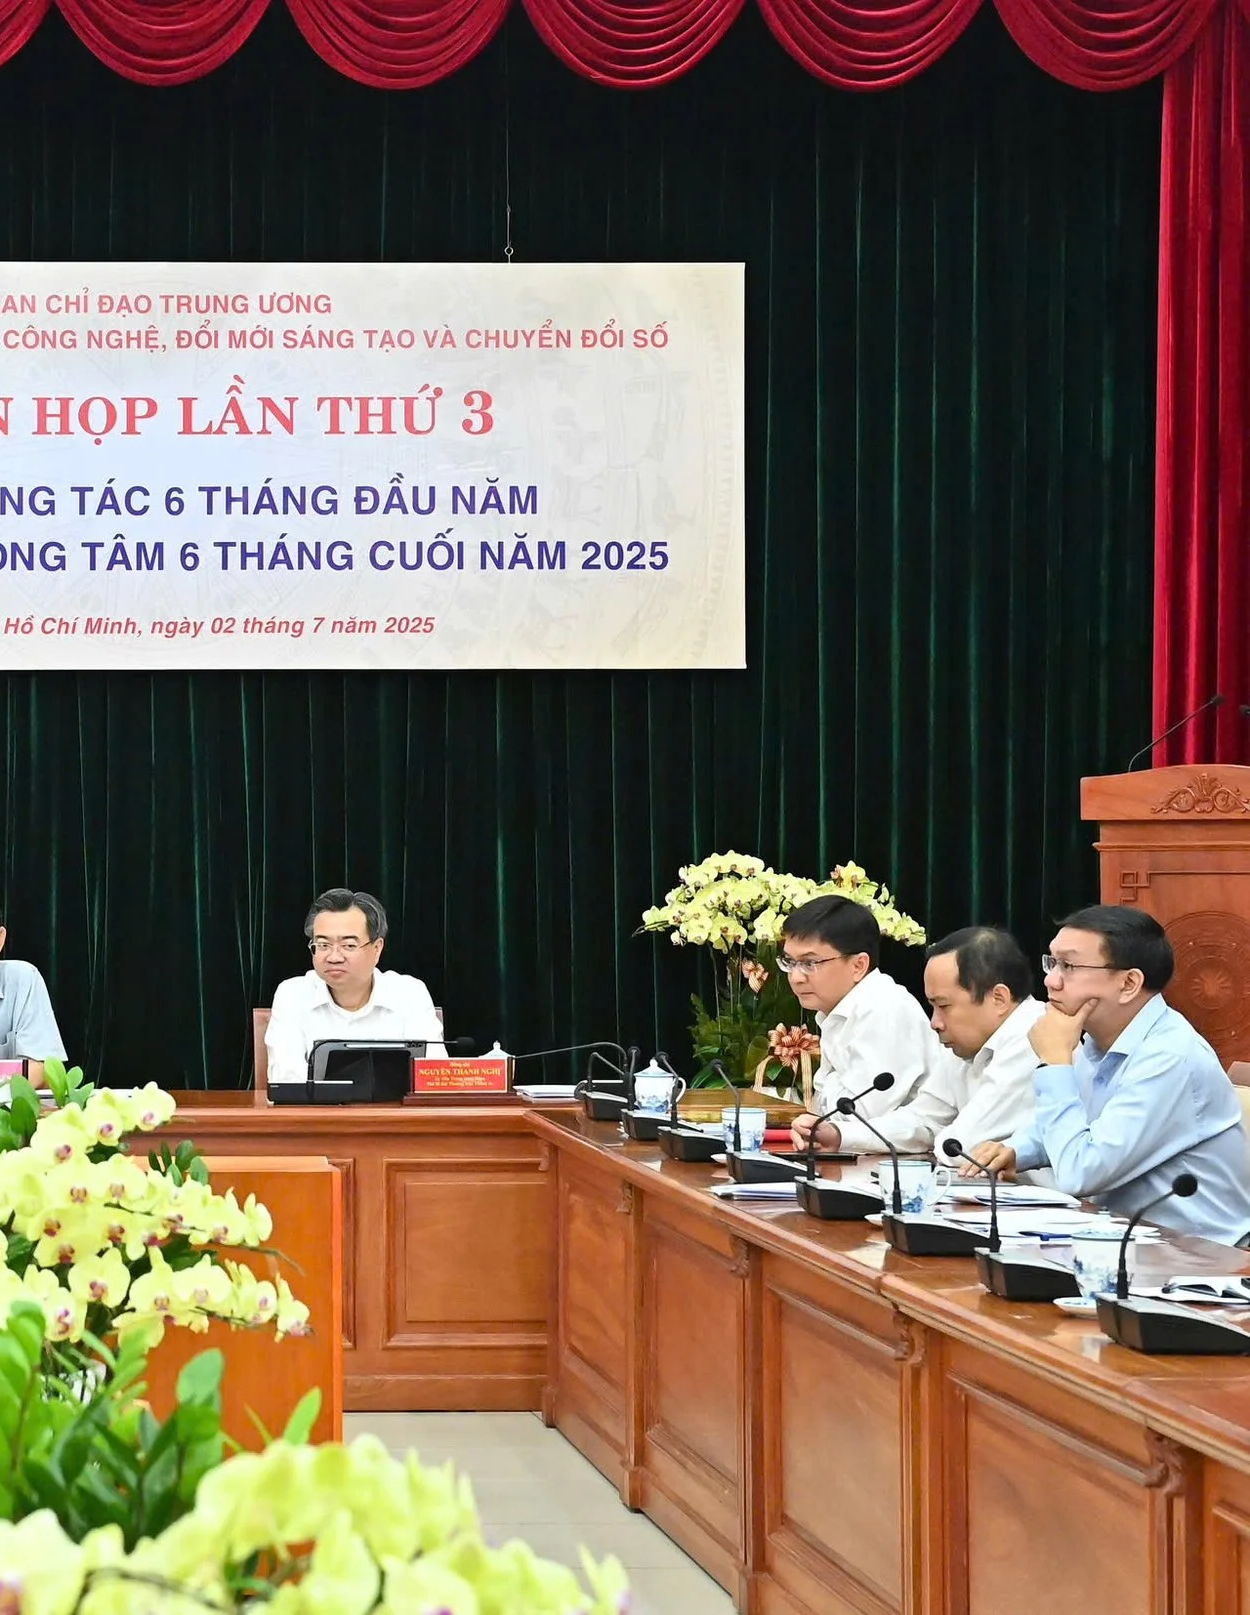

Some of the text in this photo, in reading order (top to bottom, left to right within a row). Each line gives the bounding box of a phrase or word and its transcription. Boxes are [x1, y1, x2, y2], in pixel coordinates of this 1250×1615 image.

[46, 286, 91, 316] CHỈ
[97, 293, 154, 320] ĐẠO
[159, 293, 251, 316] TRUNG
[259, 291, 334, 316] ƯƠNG
[3, 325, 79, 351] CÔNG
[87, 325, 168, 355] NGHỆ,
[176, 319, 220, 351] ĐỔI
[229, 325, 275, 351] MỚI
[283, 325, 355, 351] SÁNG
[363, 330, 416, 354] TẠO
[423, 325, 458, 350] VÀ
[466, 319, 573, 350] CHUYỂN
[581, 319, 625, 350] ĐỔI
[633, 321, 670, 350] SỐ
[32, 397, 160, 447] HỌP
[177, 374, 301, 437] LẦN
[317, 384, 445, 437] THỨ
[462, 390, 495, 437] 3
[70, 478, 152, 518] TÁC
[165, 487, 186, 518] 6
[198, 478, 340, 517] THÁNG
[354, 473, 437, 517] ĐẦU
[452, 477, 539, 516] NĂM
[81, 534, 166, 573] TÂM
[180, 542, 201, 573] 6
[213, 533, 355, 573] THÁNG
[369, 528, 466, 572] CUỐI
[480, 533, 568, 572] NĂM
[582, 541, 670, 572] 2025
[4, 615, 36, 636] Hồ
[41, 617, 80, 636] Chí
[84, 618, 144, 637] Minh,
[151, 617, 206, 640] ngày
[211, 617, 238, 636] 02
[243, 616, 306, 640] tháng
[313, 617, 327, 635] 7
[331, 617, 379, 635] năm
[384, 617, 437, 635] 2025
